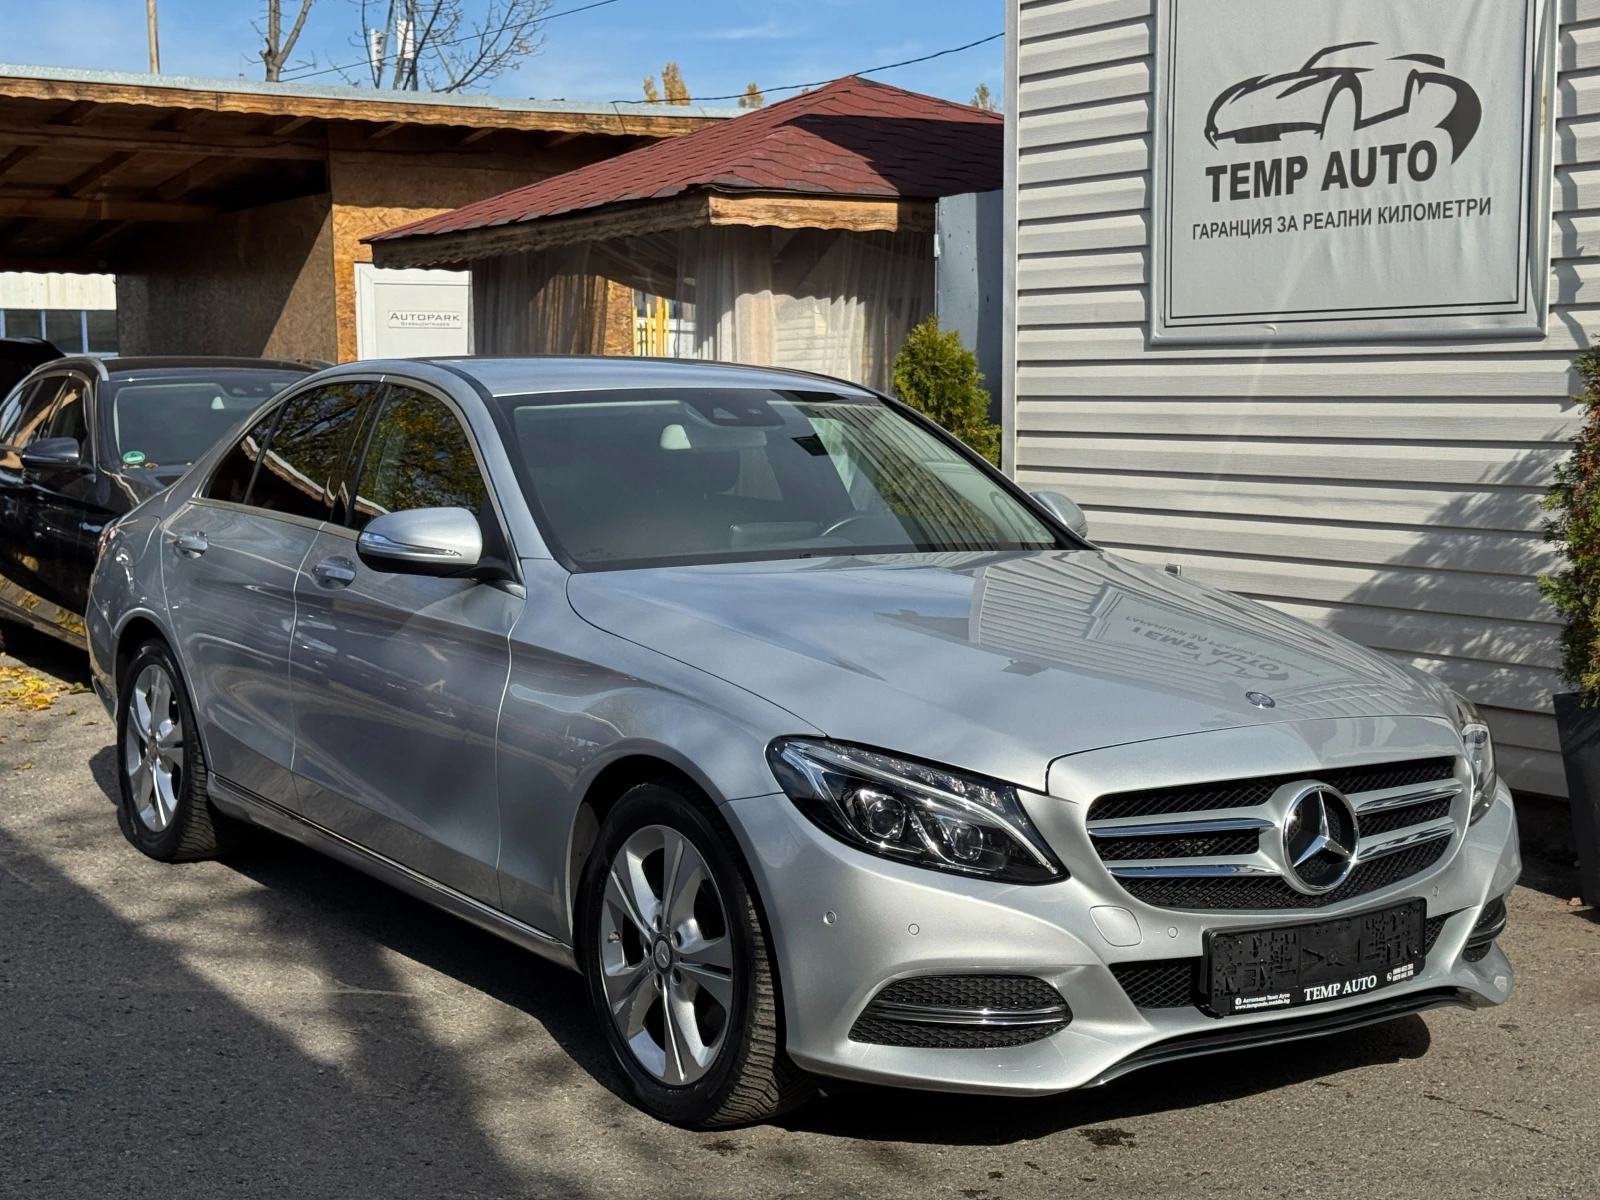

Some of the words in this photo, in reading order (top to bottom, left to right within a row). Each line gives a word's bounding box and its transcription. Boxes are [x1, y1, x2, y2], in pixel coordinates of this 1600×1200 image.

[1205, 155, 1309, 202] TEMP
[1320, 140, 1438, 191] AUTO
[1191, 217, 1273, 240] ГАРАНЦИЯ
[1276, 214, 1299, 234] ЗА
[1303, 208, 1373, 231] РЕАЛНИ
[1377, 197, 1493, 225] КИЛОМЕТРИ
[390, 312, 460, 322] AUTOPARK
[1303, 983, 1341, 1001] TEMP
[1342, 975, 1378, 995] AUTO
